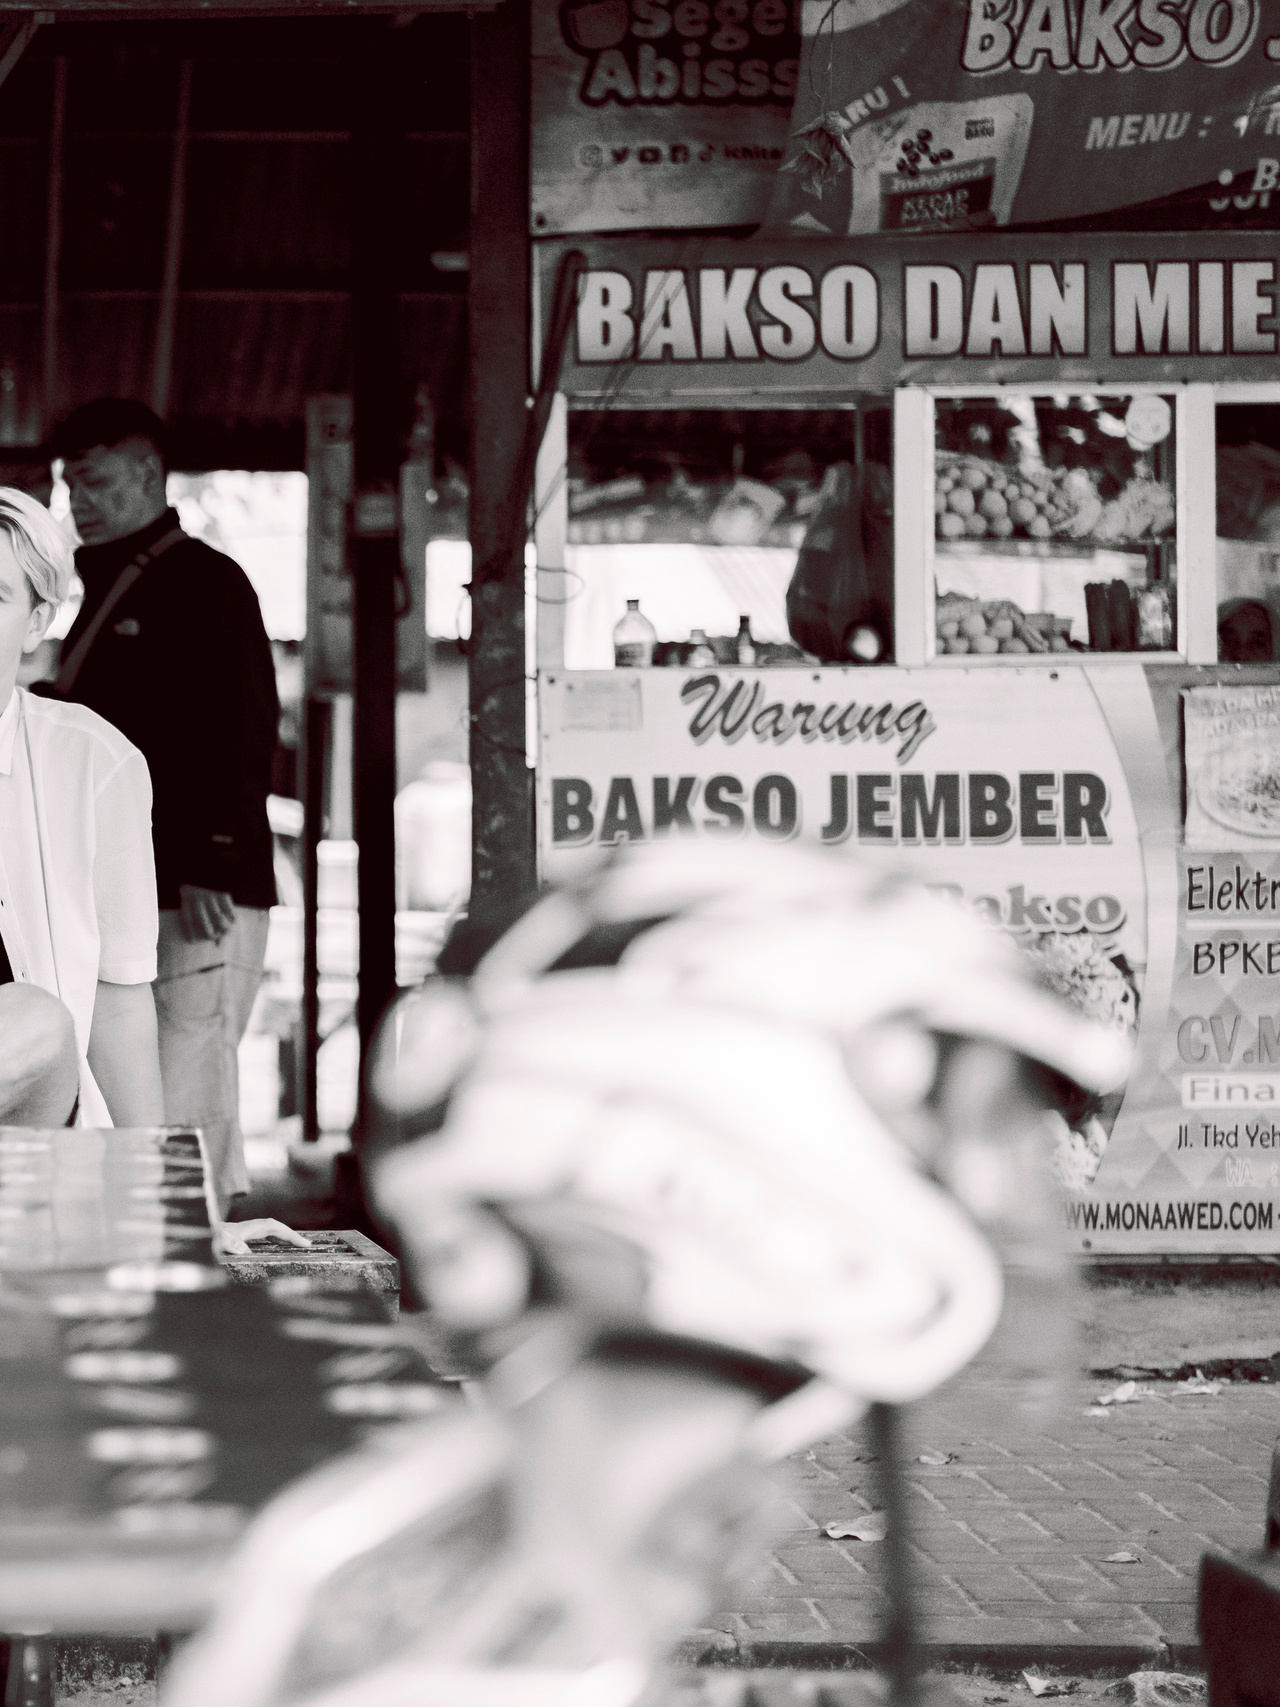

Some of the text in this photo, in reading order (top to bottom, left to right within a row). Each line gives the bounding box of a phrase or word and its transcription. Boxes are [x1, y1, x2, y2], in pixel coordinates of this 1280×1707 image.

[1084, 112, 1193, 151] MENU
[575, 260, 1279, 363] BAKSO DAN MIE
[679, 673, 939, 765] Warung
[550, 772, 1113, 846] BAKSO JEMBER
[923, 881, 1128, 934] akso
